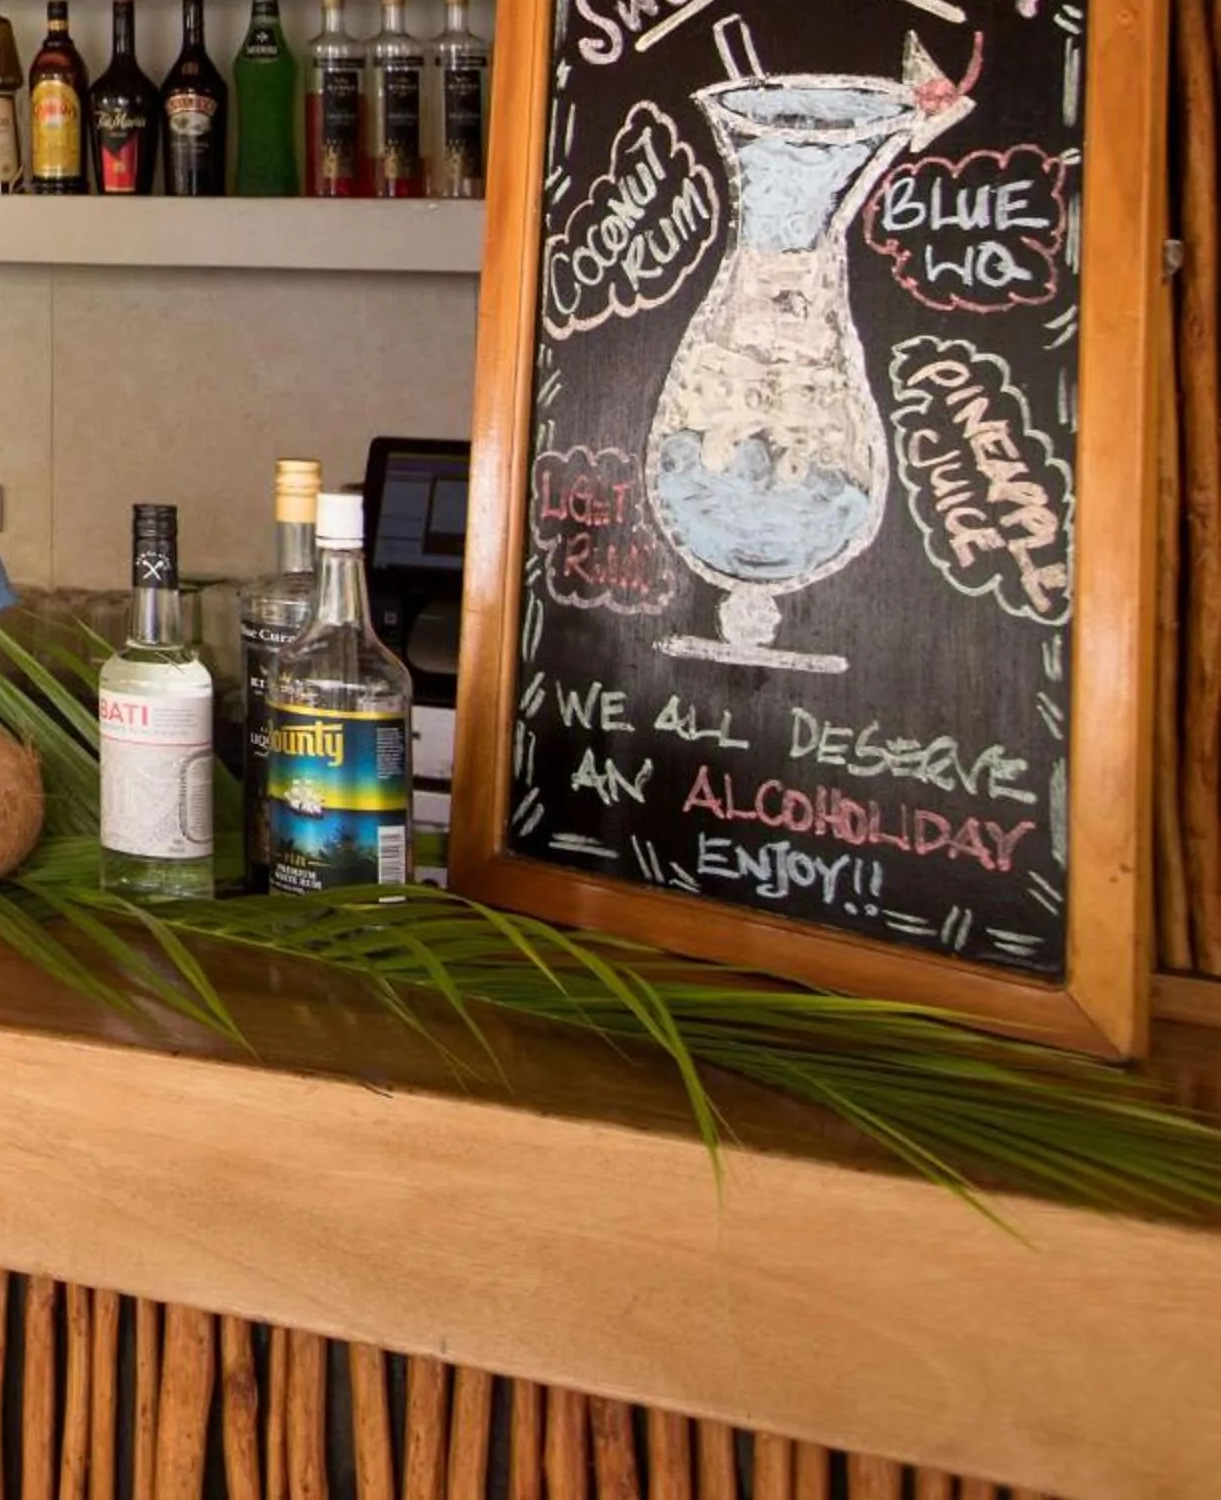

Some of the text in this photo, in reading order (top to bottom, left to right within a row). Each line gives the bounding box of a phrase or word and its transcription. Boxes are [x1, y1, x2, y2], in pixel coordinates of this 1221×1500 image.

[620, 177, 710, 291] RUM
[882, 178, 1049, 232] BLUE
[908, 428, 1006, 568] JUICE
[555, 680, 1038, 804] WE ALL DESERVE
[571, 748, 1036, 872] AN ALCOHOLIDAY
